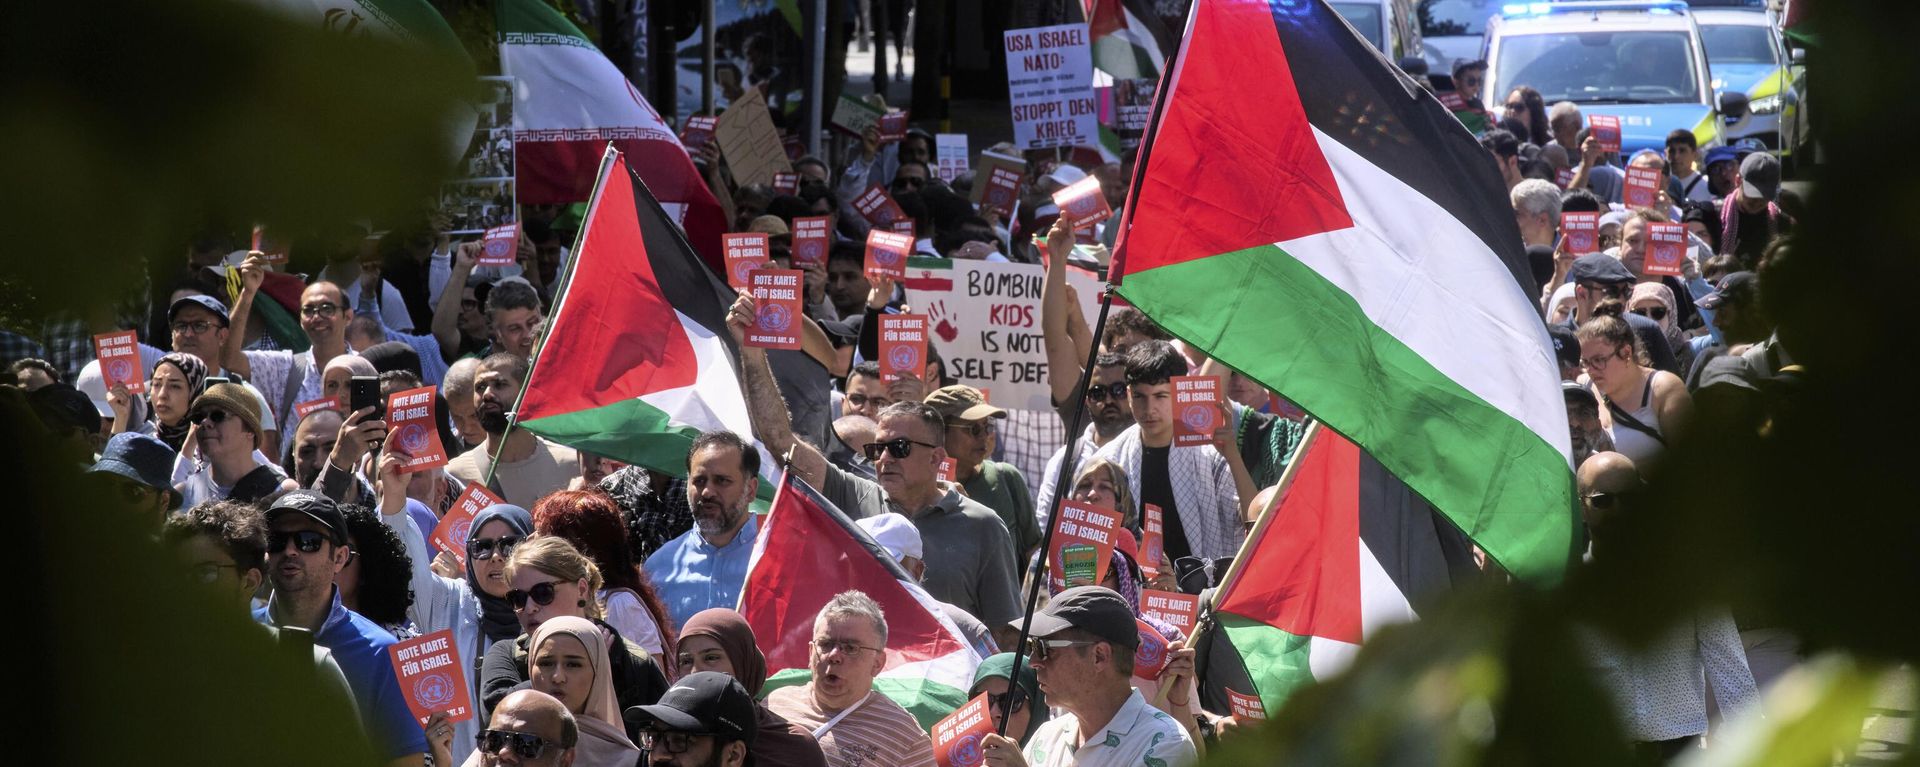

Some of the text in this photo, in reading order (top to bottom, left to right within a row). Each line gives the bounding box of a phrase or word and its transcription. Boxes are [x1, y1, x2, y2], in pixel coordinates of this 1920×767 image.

[1006, 29, 1086, 52] USA ISRAEL
[1023, 53, 1065, 72] NATO:
[1013, 98, 1095, 122] STOPPT DEN
[1035, 119, 1077, 139] KRIEG
[728, 237, 764, 247] ROTE KARTE
[742, 248, 764, 257] ISRAEL
[754, 274, 797, 286] ROTE KARTE
[967, 269, 1043, 299] BOMBIN
[753, 287, 768, 299] FÜR
[769, 288, 796, 300] ISRAEL
[884, 319, 923, 329] ROTE KARTE
[990, 304, 1034, 328] KIDS
[884, 330, 923, 342] FÜR ISRAEL
[981, 330, 1045, 353] IS NOT
[951, 358, 1049, 385] SELF DEF
[1176, 380, 1216, 391] ROTE KARTE
[392, 392, 430, 408] ROTE KARTE
[1177, 391, 1216, 403] FÜR ISRAEL
[392, 405, 429, 422] FÜR ISRAEL
[470, 487, 490, 506] ROTE
[461, 499, 478, 516] FÜR
[1063, 506, 1115, 529] ROTE KARTE
[1059, 520, 1109, 545] FÜR ISRAEL
[1147, 596, 1192, 612] ROTE KARTE
[1162, 612, 1189, 626] ISRAEL
[397, 637, 449, 662] ROTE KARTE
[401, 653, 453, 678] FÜR ISRAEL
[938, 700, 983, 734] ROTE KARTE
[938, 711, 984, 746] FÜR ISRAEL
